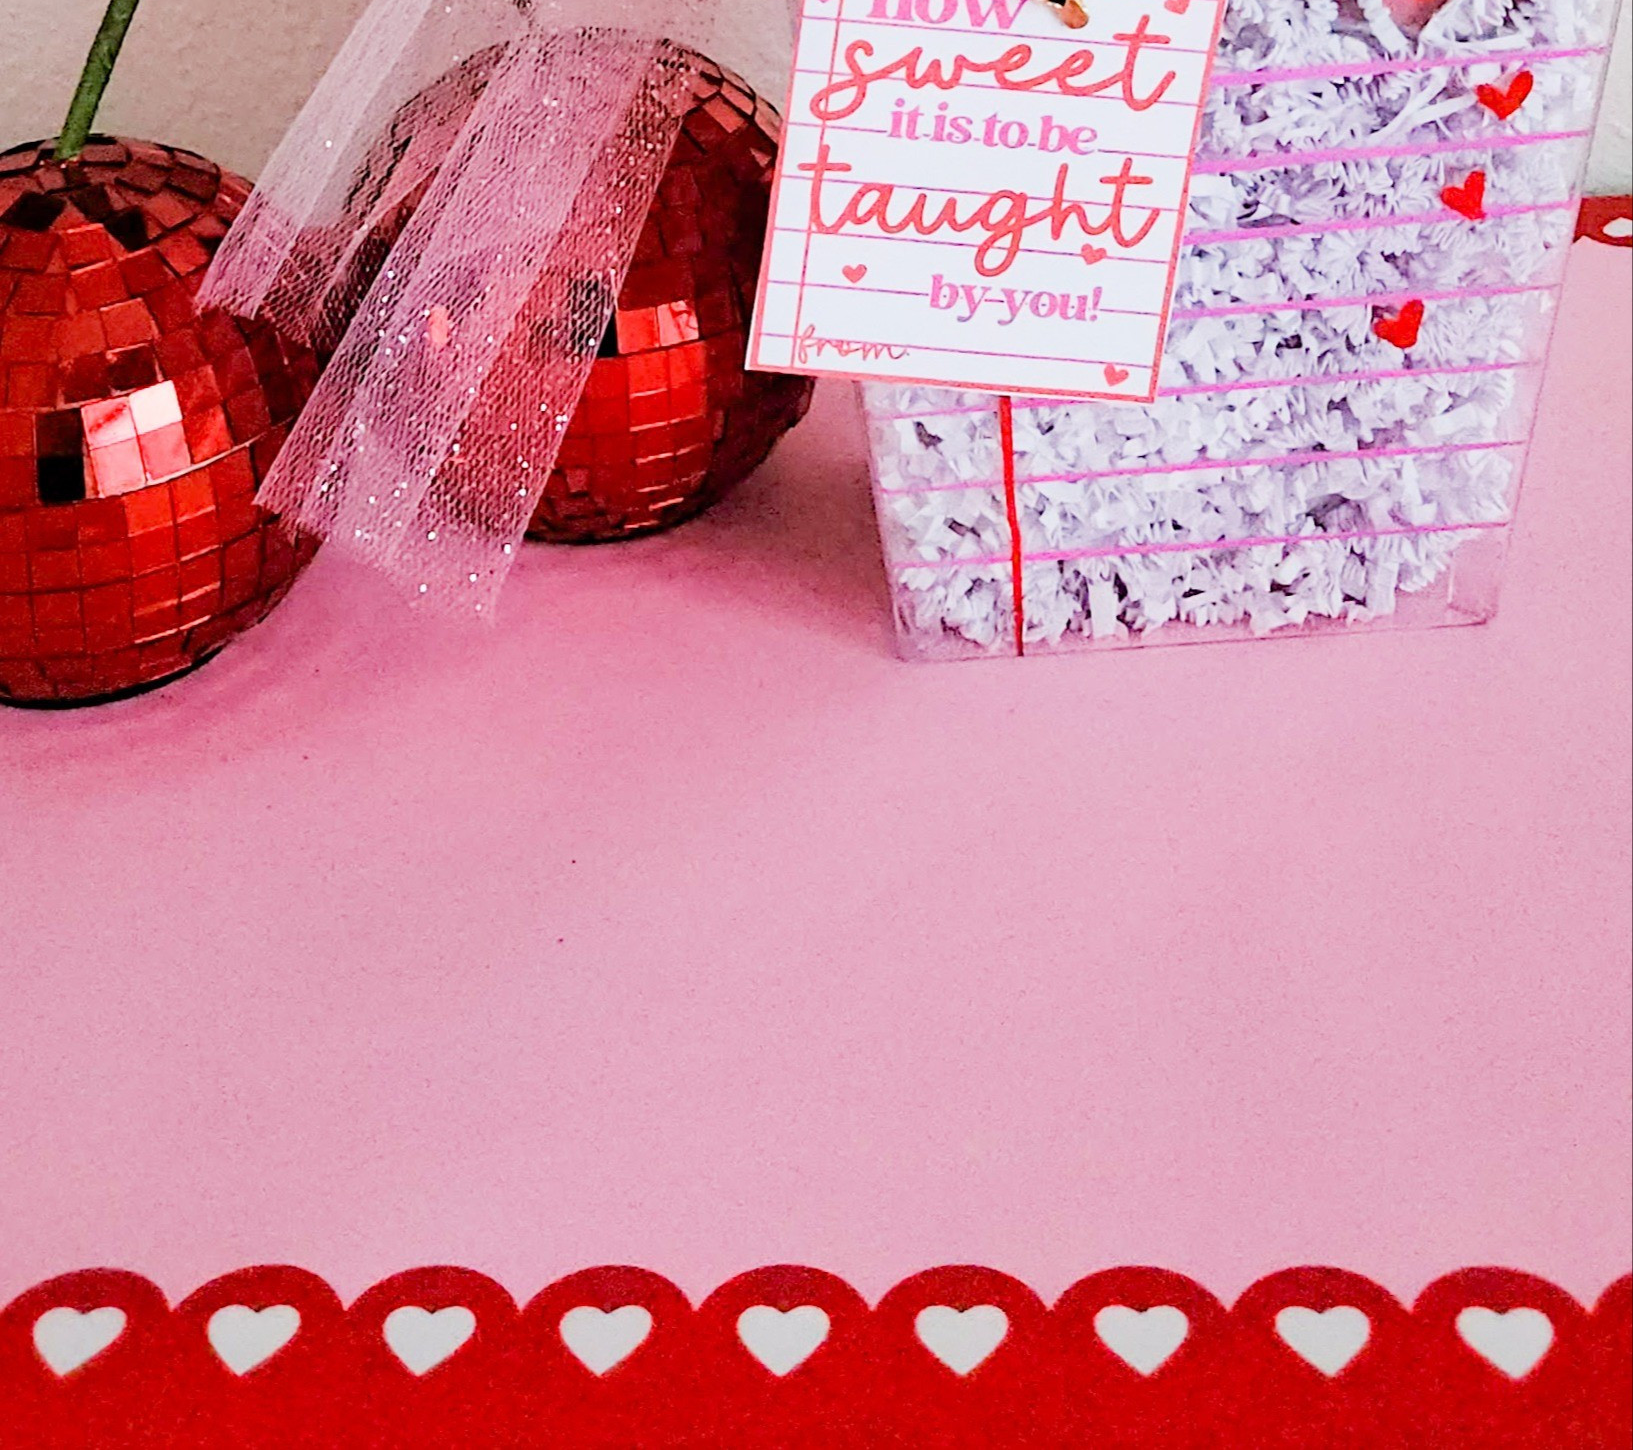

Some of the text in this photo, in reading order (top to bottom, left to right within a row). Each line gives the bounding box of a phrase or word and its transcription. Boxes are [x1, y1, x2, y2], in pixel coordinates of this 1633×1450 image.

[810, 14, 1176, 120] sweet
[887, 98, 1098, 156] it is to be
[798, 144, 1162, 278] taught
[929, 273, 1103, 327] by you!
